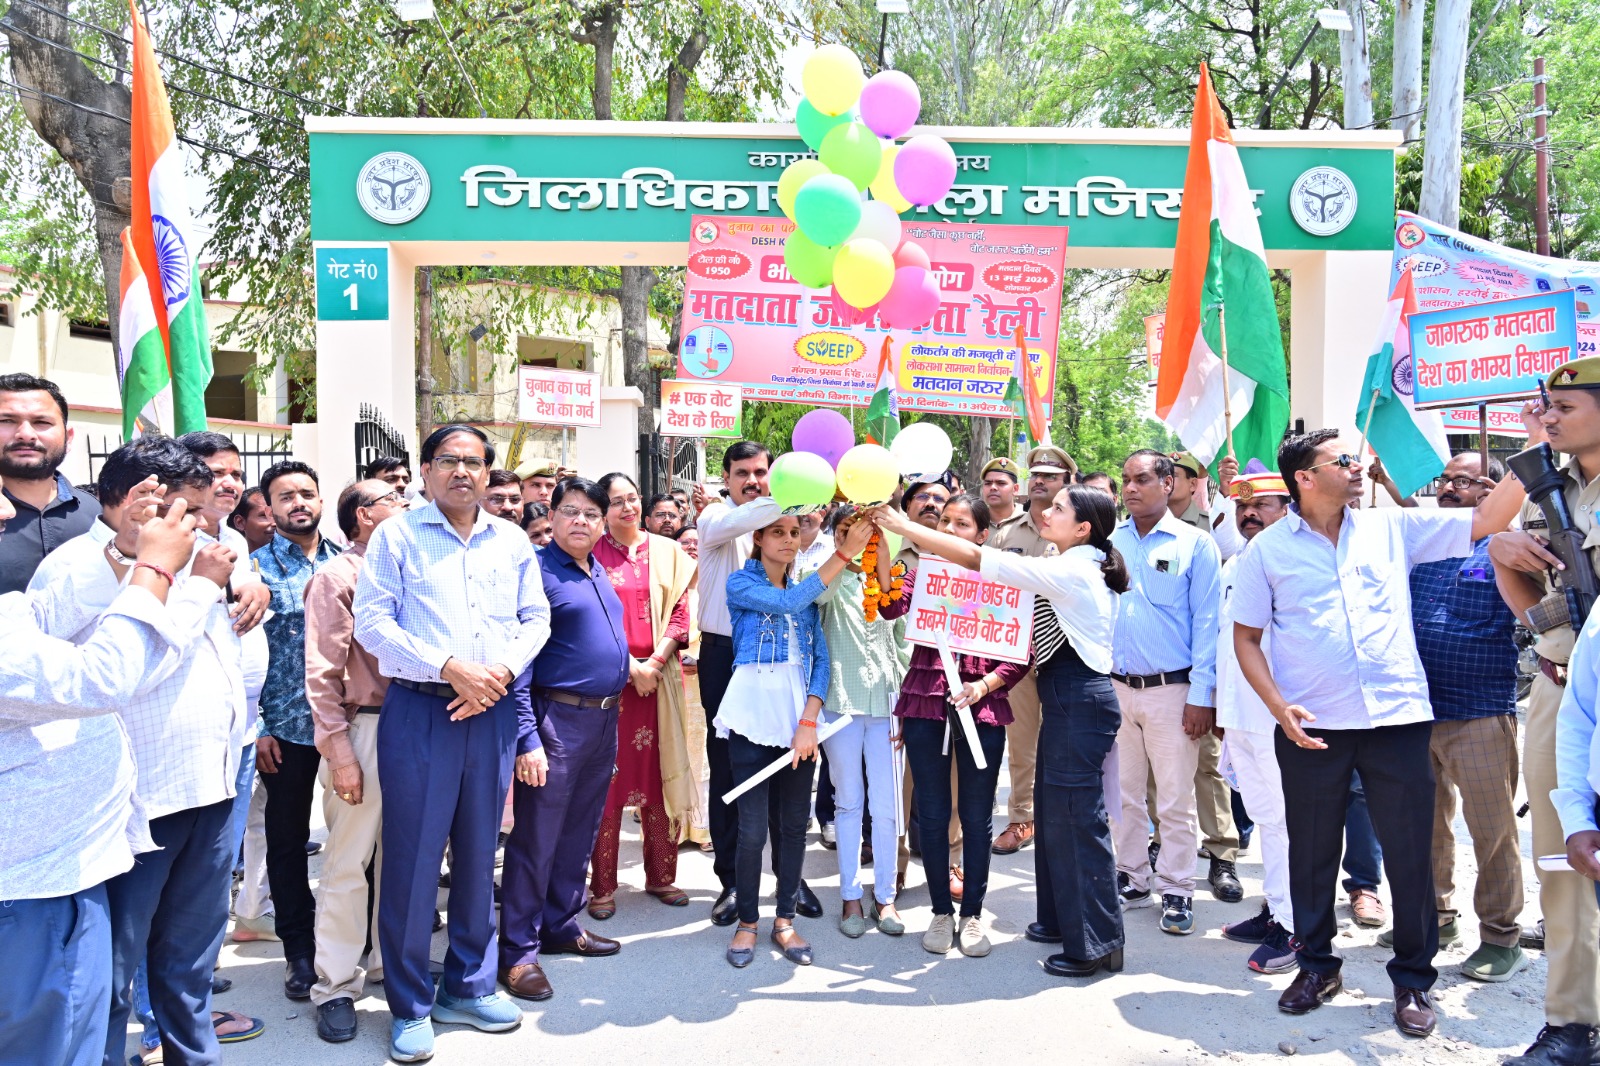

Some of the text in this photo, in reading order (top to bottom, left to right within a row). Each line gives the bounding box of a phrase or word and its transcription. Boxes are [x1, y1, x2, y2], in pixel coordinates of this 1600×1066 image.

[727, 222, 755, 236] चुनाव
[760, 223, 776, 233] का
[751, 236, 776, 246] DESH
[326, 257, 351, 280] गेट
[705, 267, 731, 275] 1950
[1003, 273, 1023, 283] मई
[1025, 275, 1048, 284] 2024
[343, 283, 358, 311] 1
[1457, 287, 1491, 299] हरदोई
[690, 289, 801, 325] मतदाता
[973, 293, 1045, 338] रैली
[1494, 306, 1556, 338] मतदाता
[806, 339, 854, 358] SWEEP
[911, 344, 949, 358] लोकतंत्र
[951, 346, 966, 358] की
[968, 348, 1004, 363] मजबूती
[791, 365, 817, 375] मंगला
[820, 368, 842, 377] प्रसाद
[906, 359, 942, 372] लोकसभा
[945, 363, 975, 374] सामान्य
[1033, 366, 1043, 378] में
[1417, 343, 1570, 387] देश का भाग्य विधाता
[525, 378, 592, 398] चुनाव का पर्व
[913, 376, 964, 392] मतदान
[684, 391, 708, 407] एक
[710, 389, 733, 407] वोट
[758, 388, 778, 396] खाद्य
[780, 388, 796, 397] एवं
[796, 389, 825, 400] औषधि
[969, 401, 997, 412] अप्रैल
[536, 397, 595, 419] देश का गर्व
[667, 408, 736, 431] देश के लिए
[926, 568, 951, 598] सारे
[950, 577, 980, 603] काम
[916, 605, 1021, 647] सबसे पहले वोट दो
